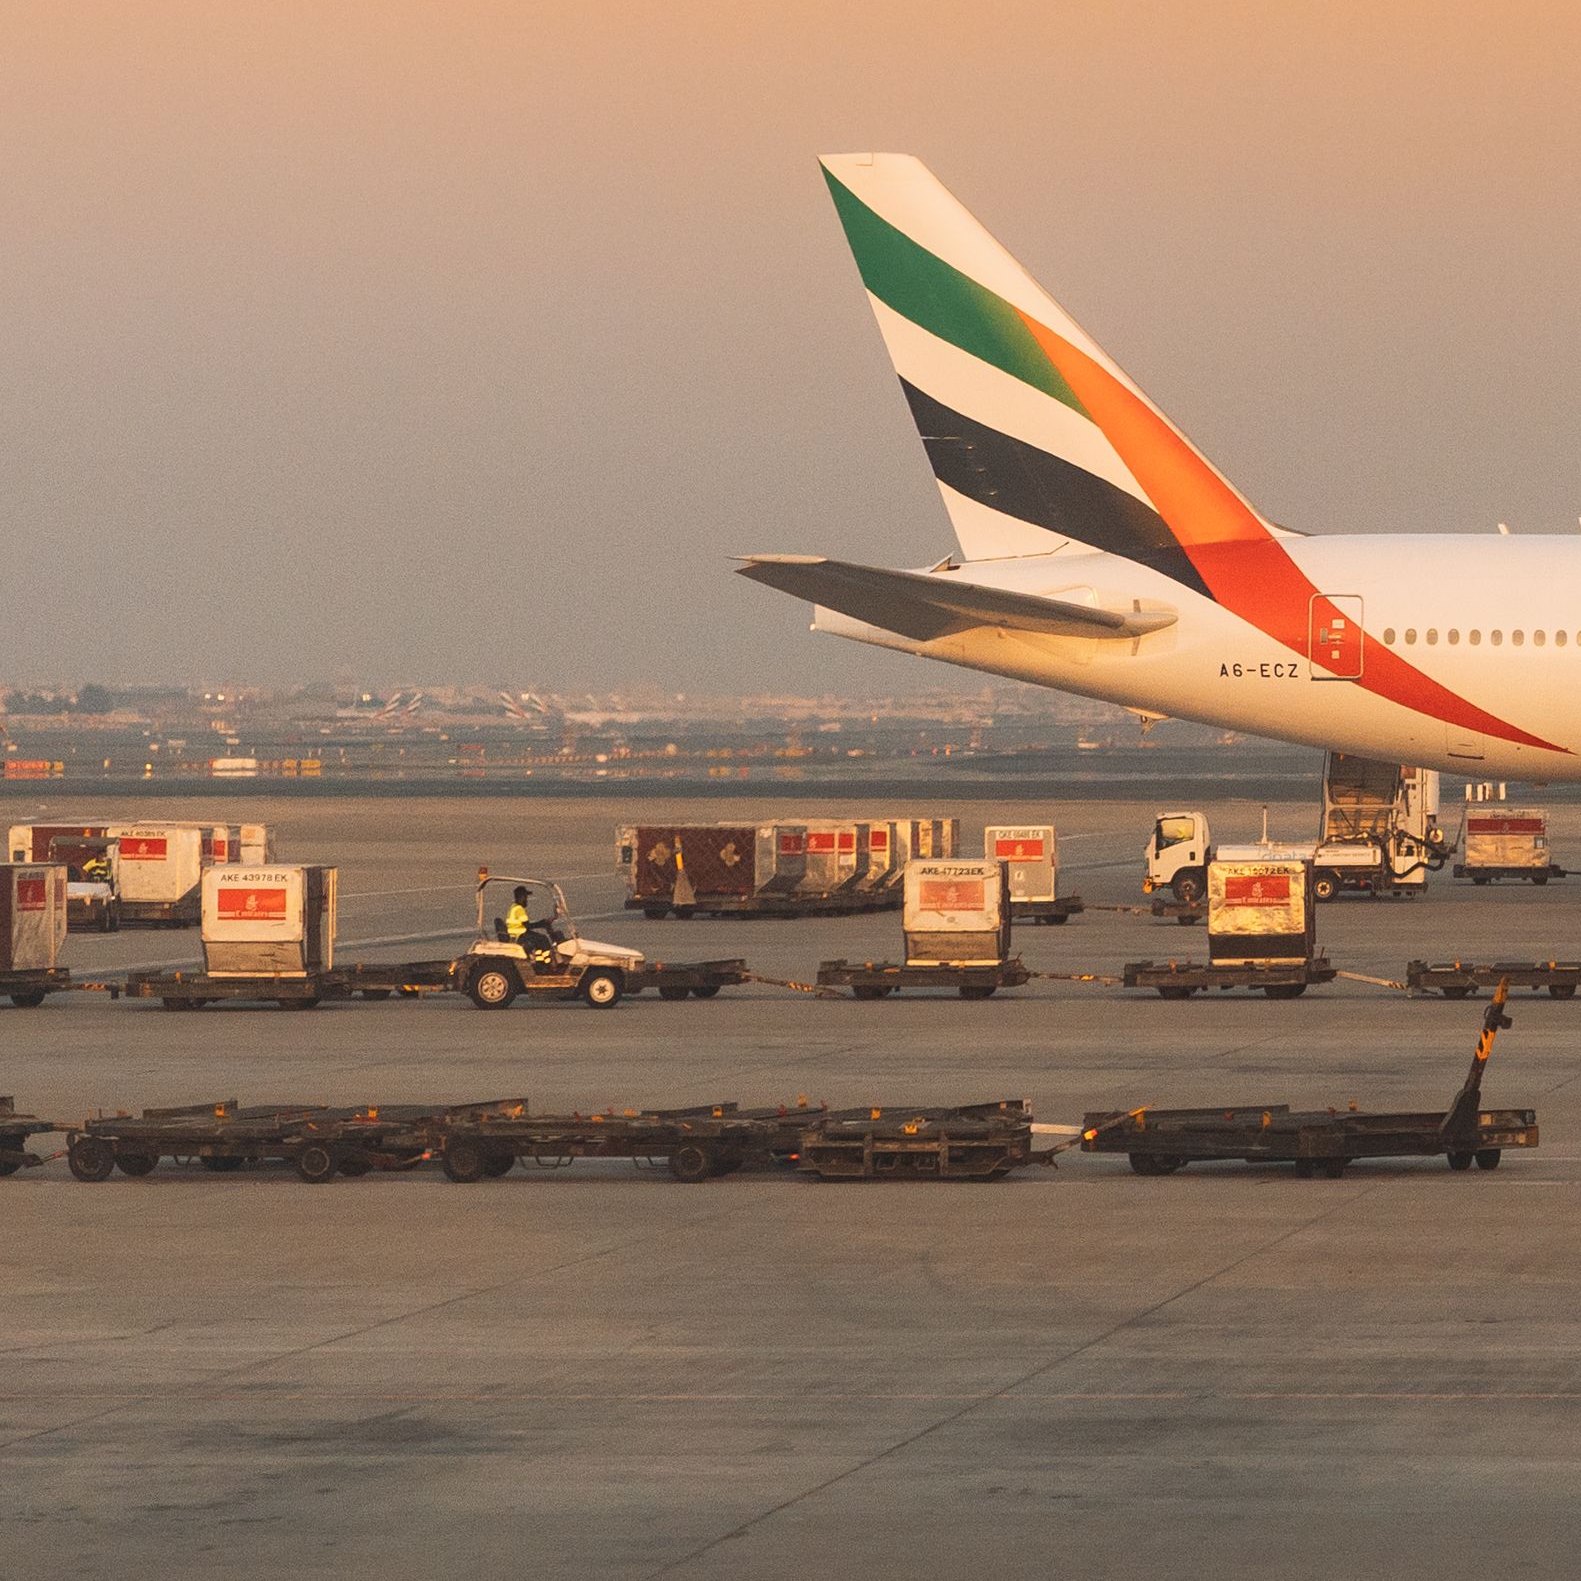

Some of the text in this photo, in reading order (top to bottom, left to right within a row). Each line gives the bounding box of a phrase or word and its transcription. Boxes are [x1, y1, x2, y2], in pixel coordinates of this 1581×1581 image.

[1219, 662, 1299, 679] A6-ECZ
[220, 873, 239, 882] AKE
[274, 873, 288, 882] EK
